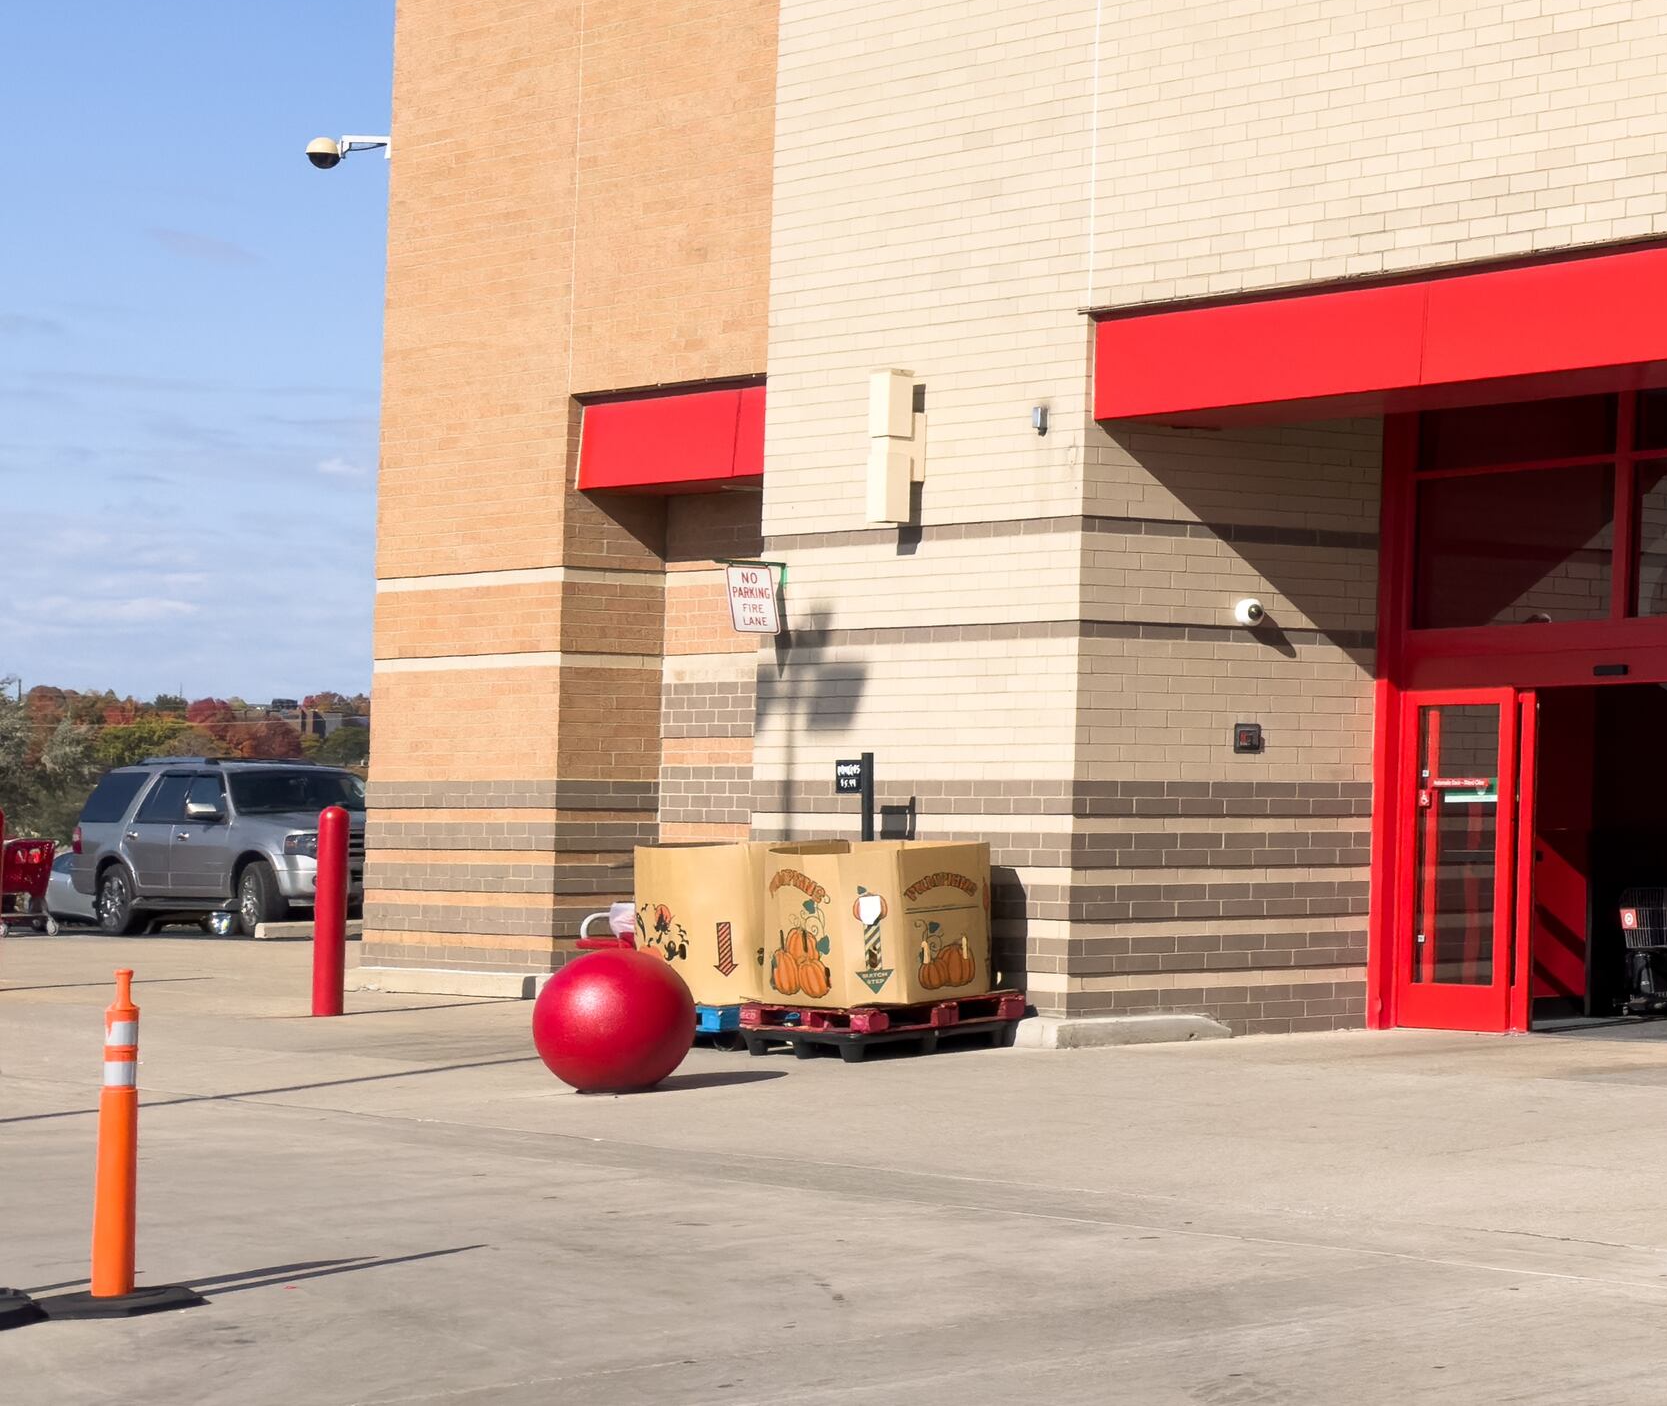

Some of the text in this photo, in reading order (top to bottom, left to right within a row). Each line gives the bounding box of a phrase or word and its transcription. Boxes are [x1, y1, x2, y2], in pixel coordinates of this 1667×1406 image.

[741, 572, 758, 584] NO
[732, 586, 771, 599] PARKING
[742, 603, 765, 614] FIRE
[743, 616, 769, 627] LANE
